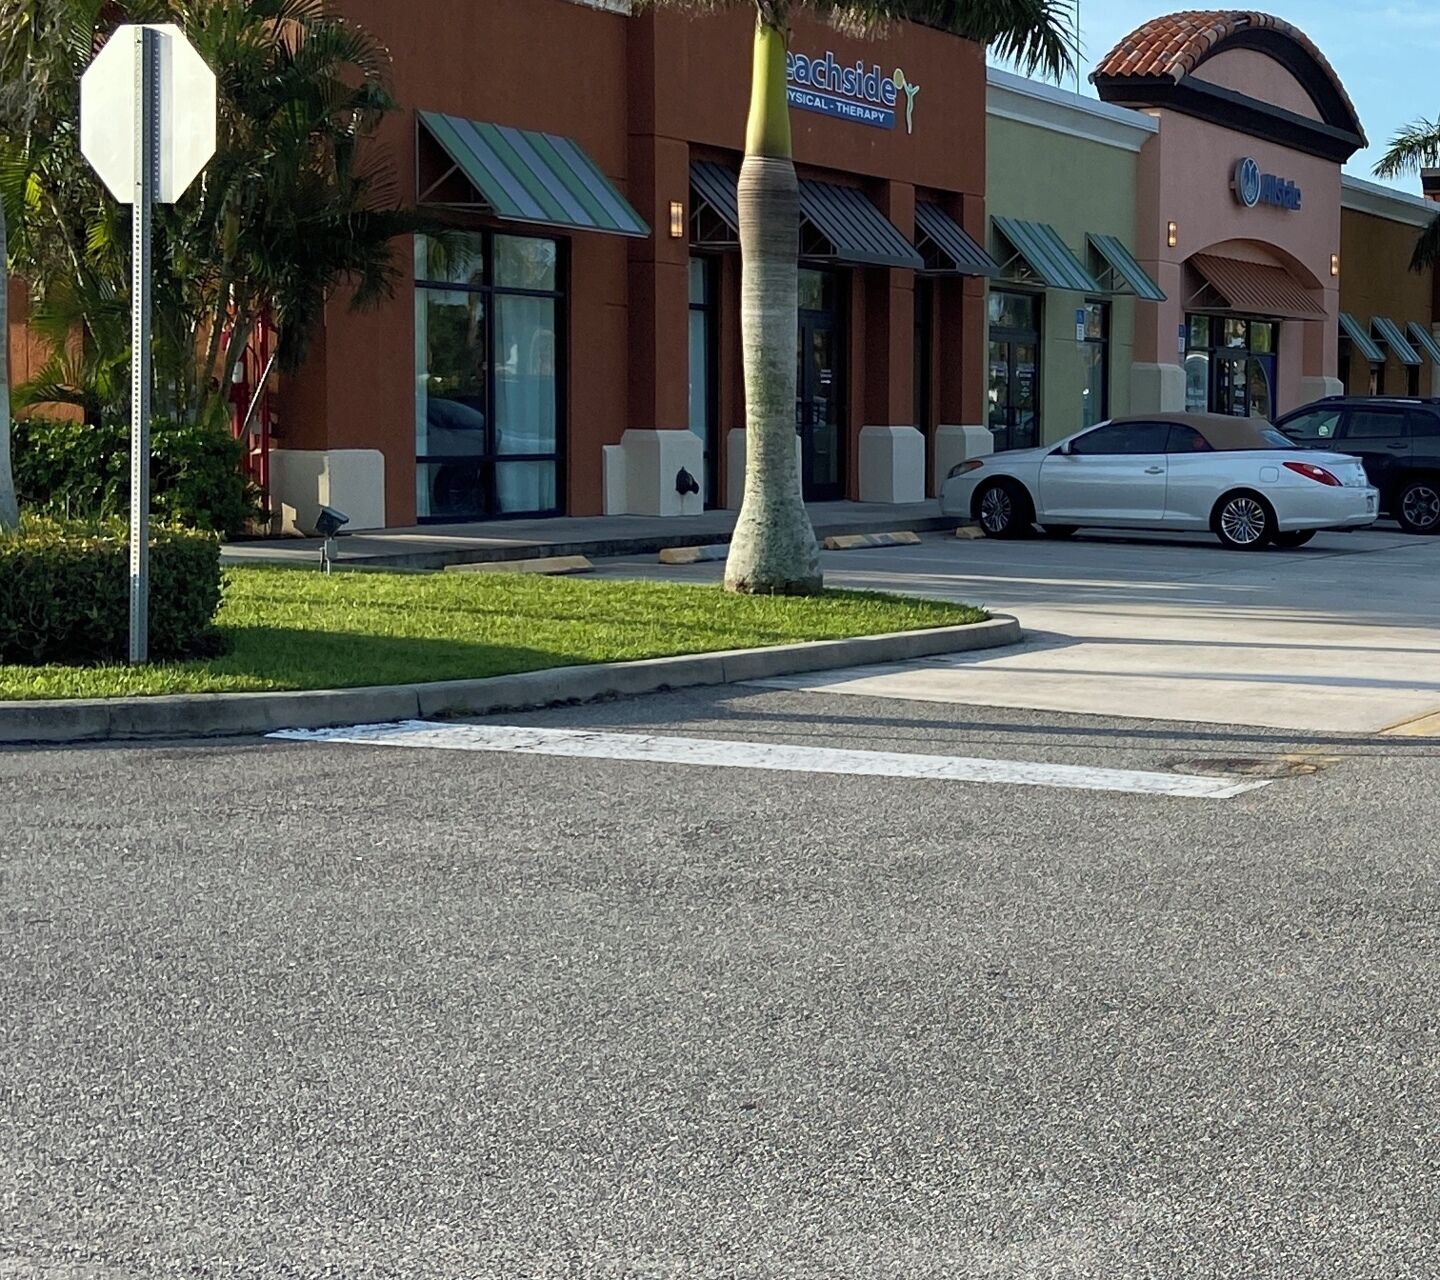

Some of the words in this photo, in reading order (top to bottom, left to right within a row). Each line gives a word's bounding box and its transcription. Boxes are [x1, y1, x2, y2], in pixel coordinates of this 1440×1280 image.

[786, 51, 897, 106] eachside
[786, 90, 828, 110] YSICAL
[836, 102, 885, 122] THERAPY
